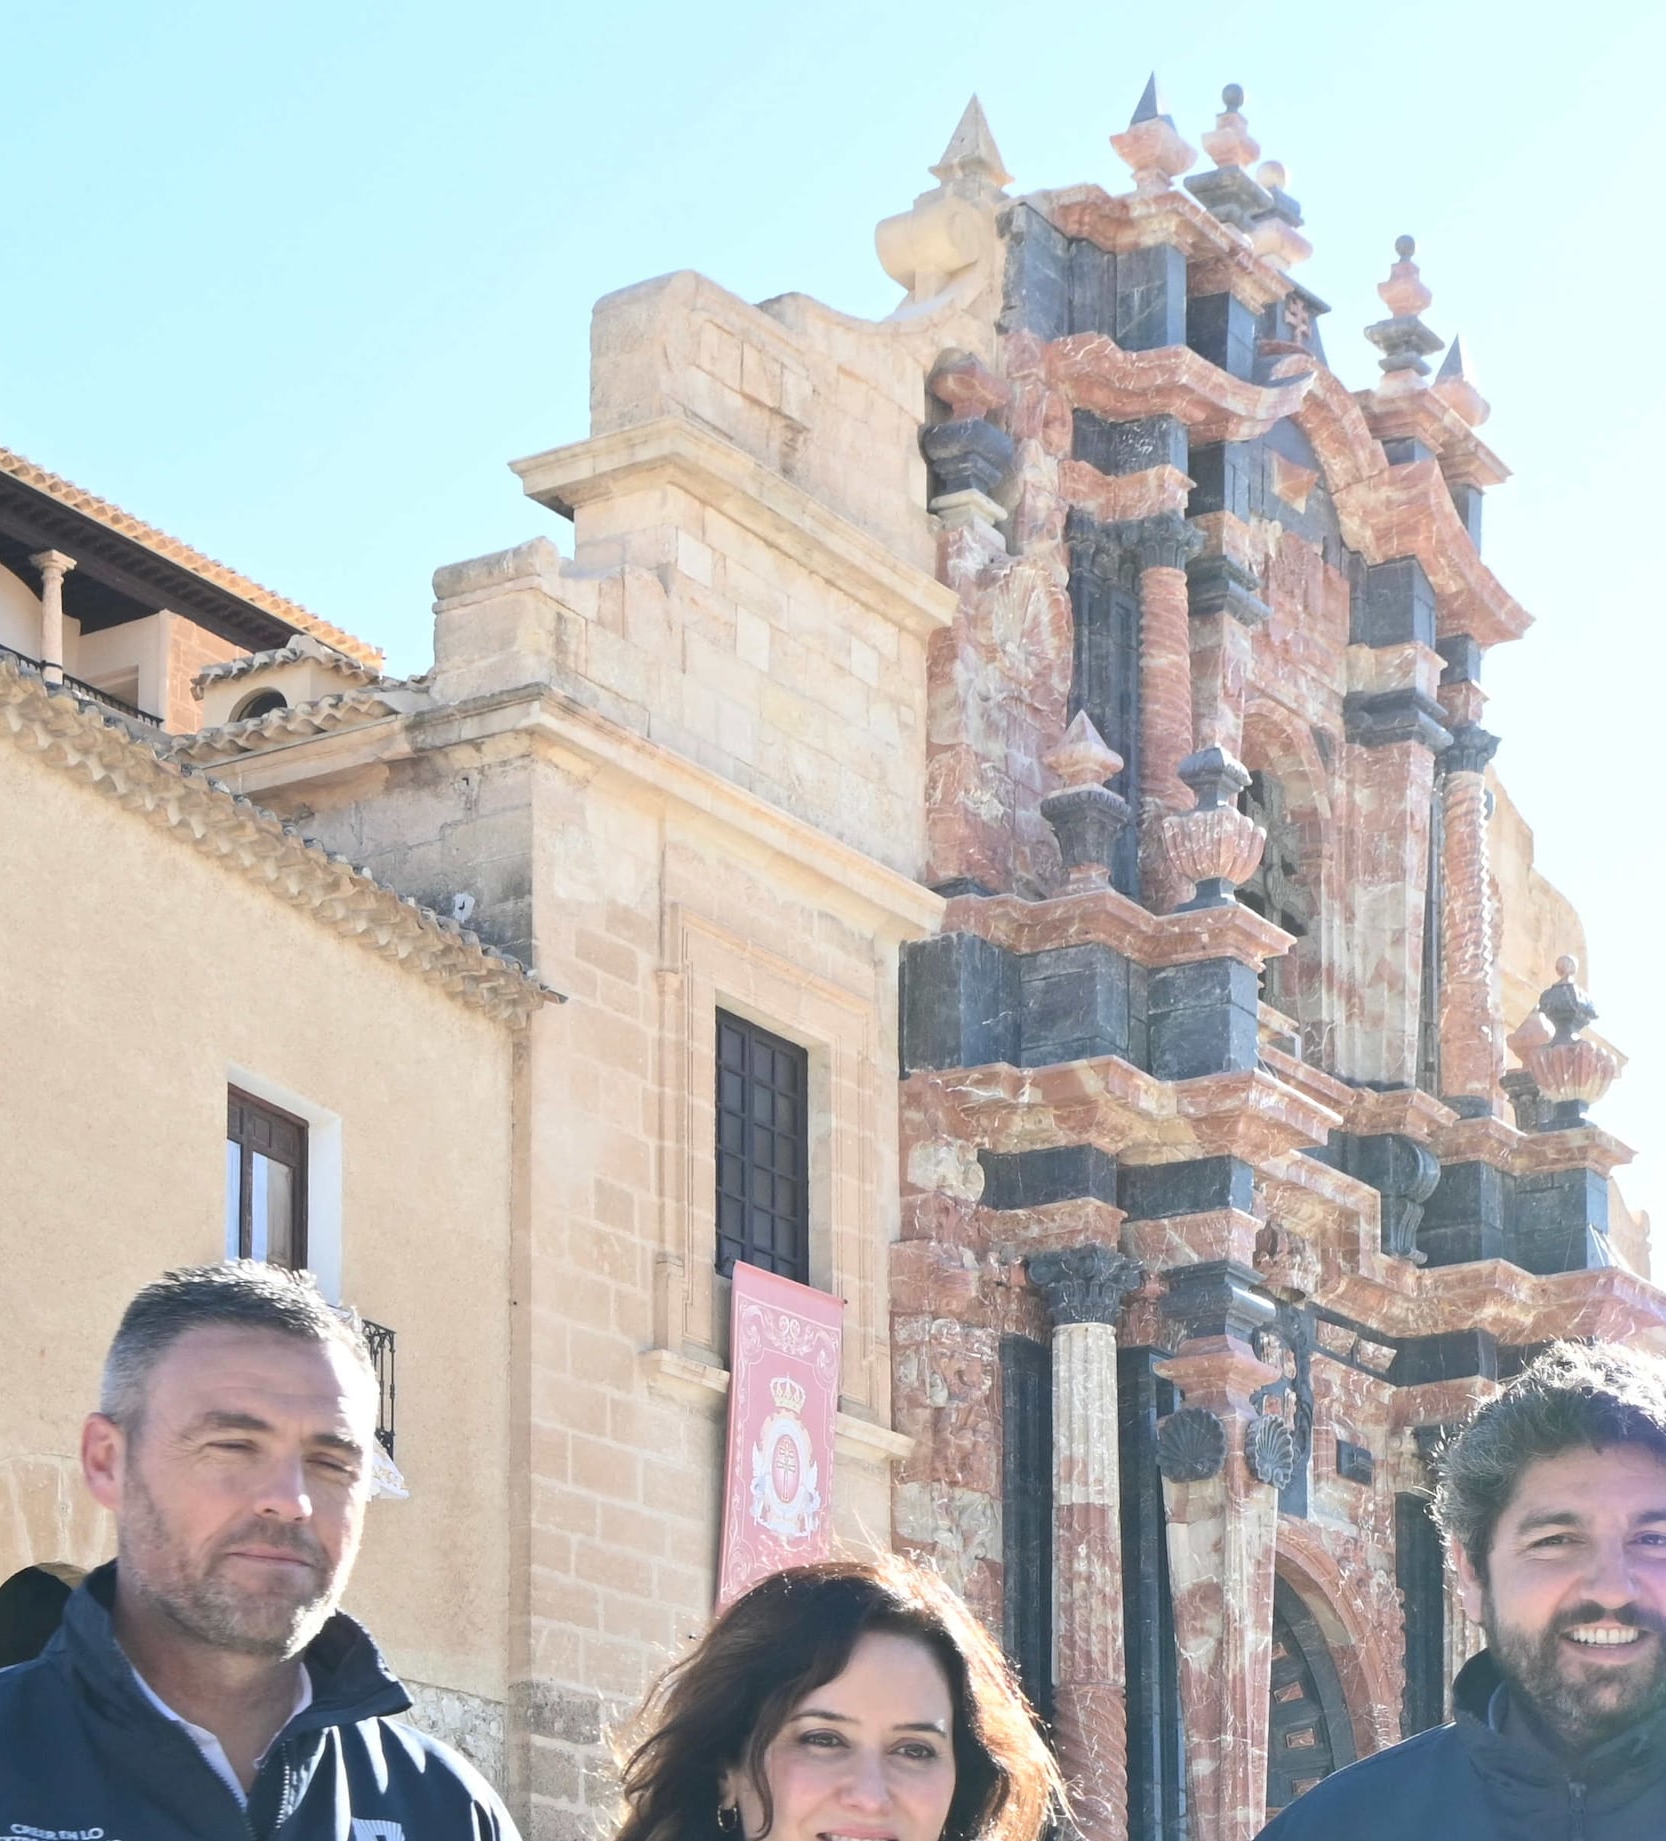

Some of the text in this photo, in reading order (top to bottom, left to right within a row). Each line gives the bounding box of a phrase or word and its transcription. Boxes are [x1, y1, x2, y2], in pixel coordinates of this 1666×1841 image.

[10, 1823, 104, 1840] CREER EN LO
